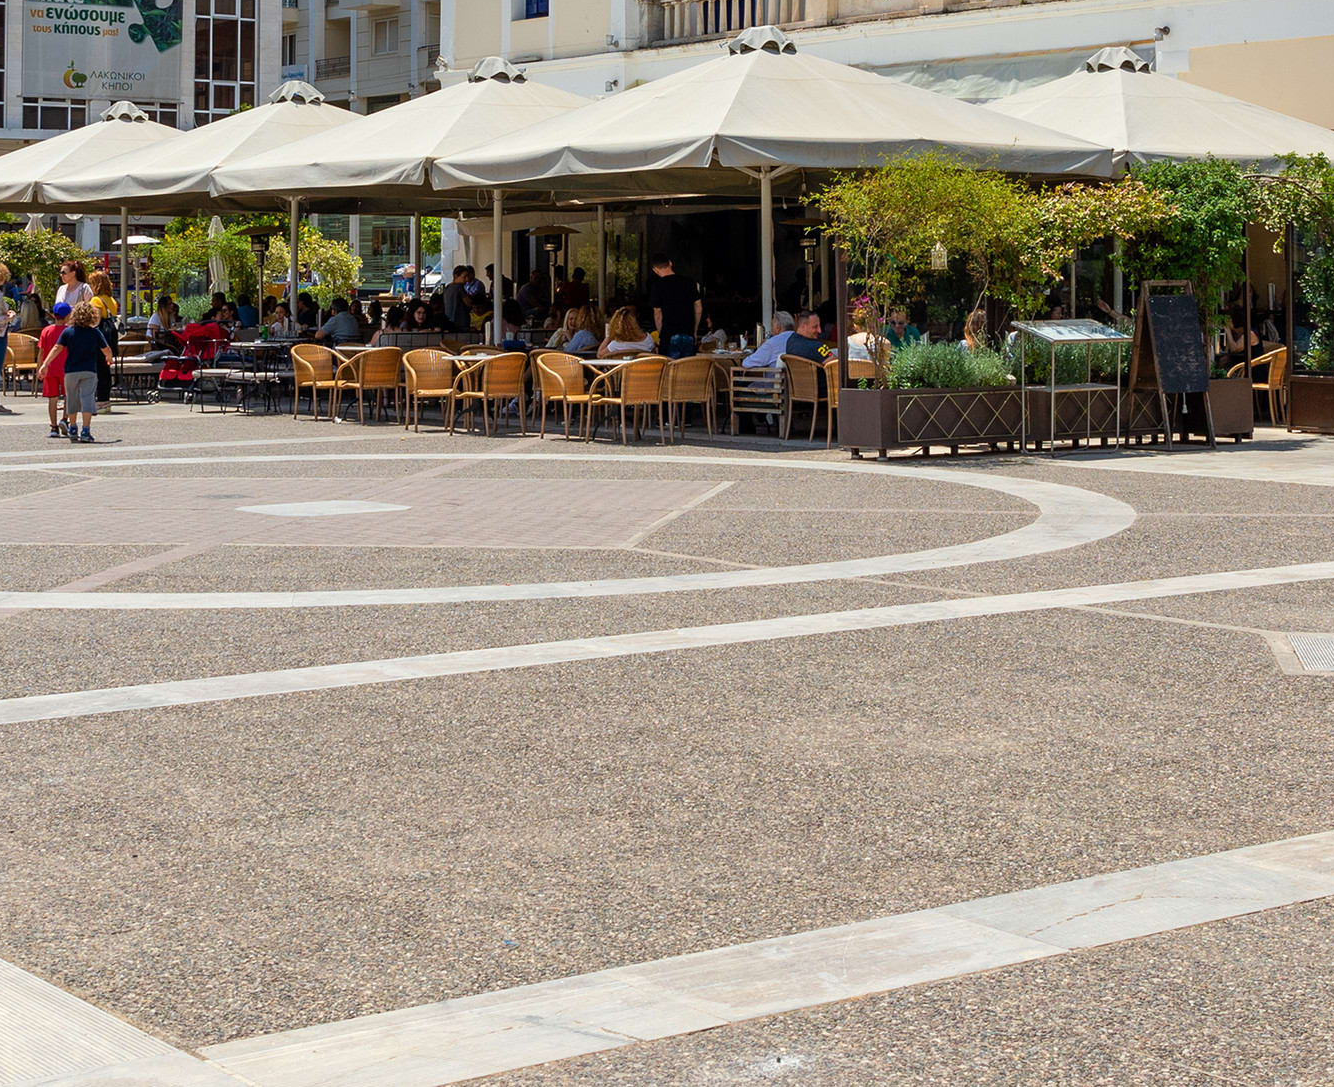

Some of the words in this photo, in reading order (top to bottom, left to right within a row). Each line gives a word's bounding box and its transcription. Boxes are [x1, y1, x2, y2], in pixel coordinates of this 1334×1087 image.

[30, 9, 44, 18] να
[46, 5, 126, 26] ενώσουμε
[32, 25, 52, 33] τους
[54, 22, 101, 35] κήπους
[90, 71, 145, 81] ΛΑΚΩΝΙΚΟΙ
[101, 82, 133, 91] ΚΗΠΟΙ
